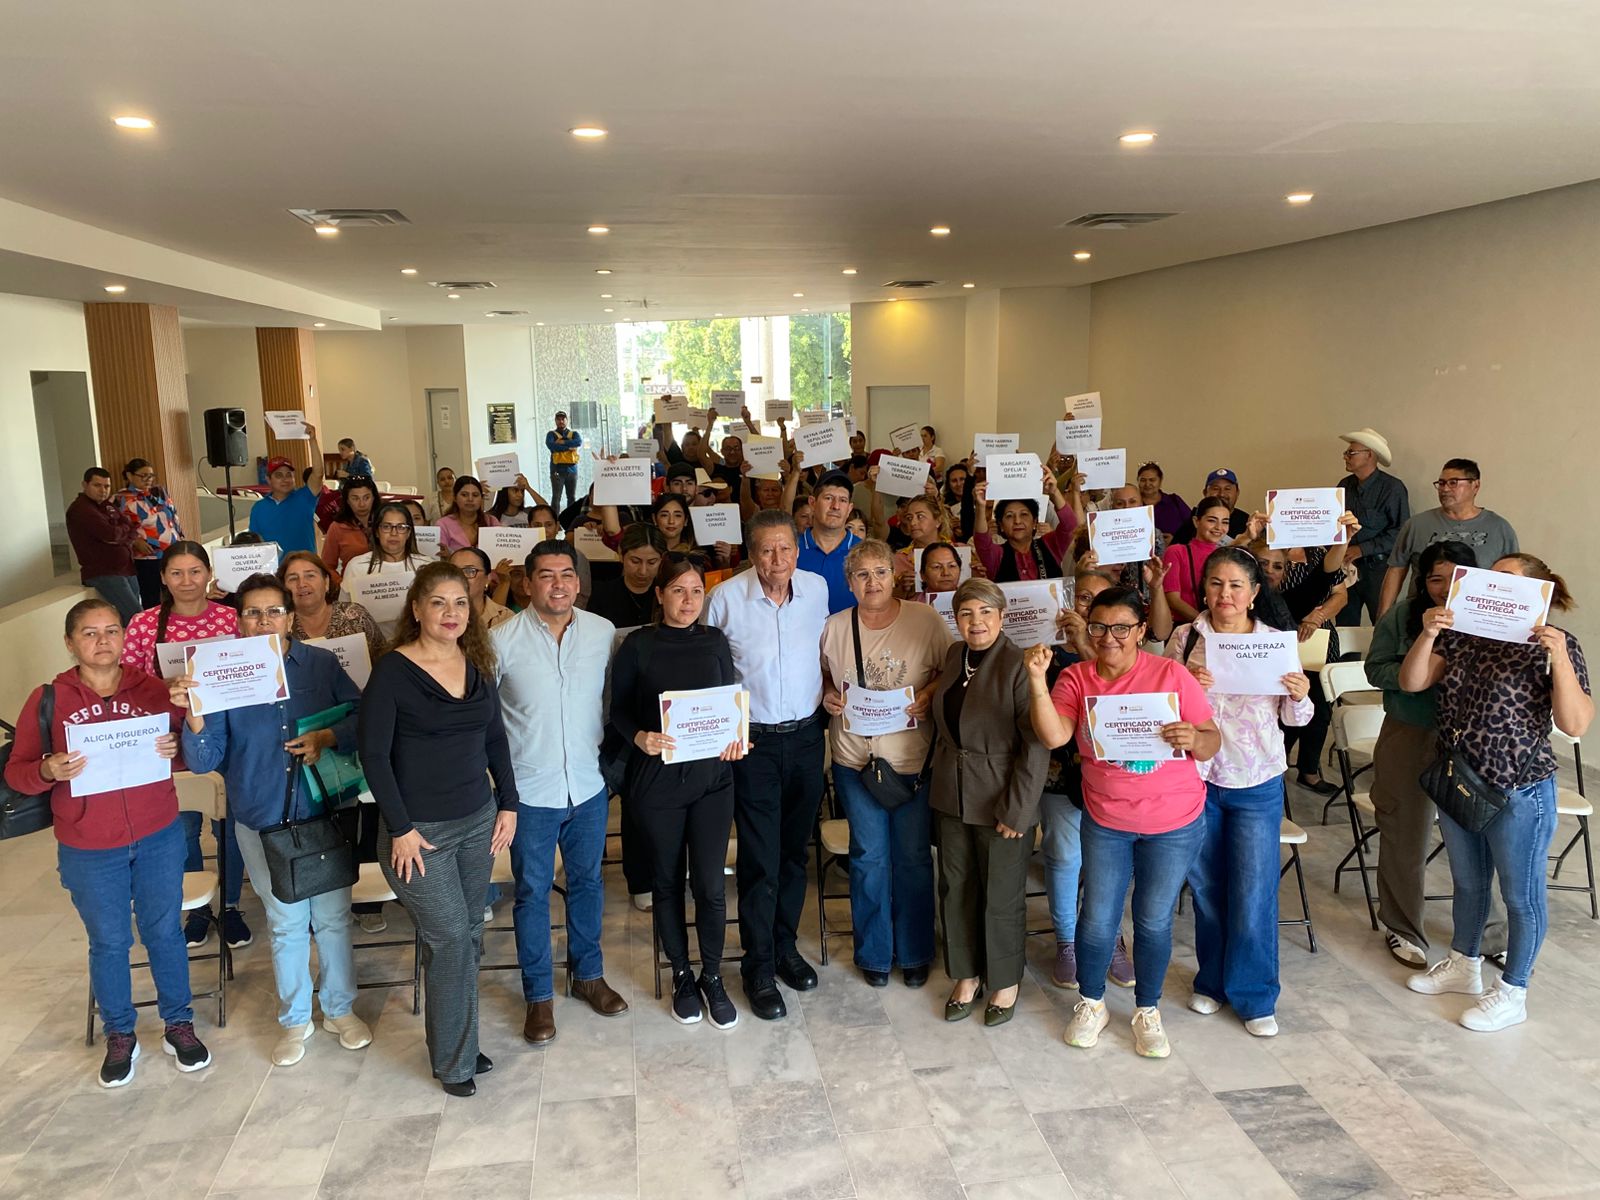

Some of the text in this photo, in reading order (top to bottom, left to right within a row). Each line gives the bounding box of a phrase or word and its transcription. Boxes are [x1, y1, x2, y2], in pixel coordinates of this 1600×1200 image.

[810, 439, 832, 448] GERARDO
[1465, 595, 1517, 609] CERTIFICADO
[1477, 604, 1515, 614] ENTREGA
[202, 665, 255, 677] CERTIFICADO
[217, 670, 255, 681] ENTREGA
[677, 719, 720, 729] CERTIFICADO
[688, 725, 719, 733] ENTREGA
[83, 727, 160, 743] ALICIA FIGUEROA
[109, 740, 138, 750] LOPEZ
